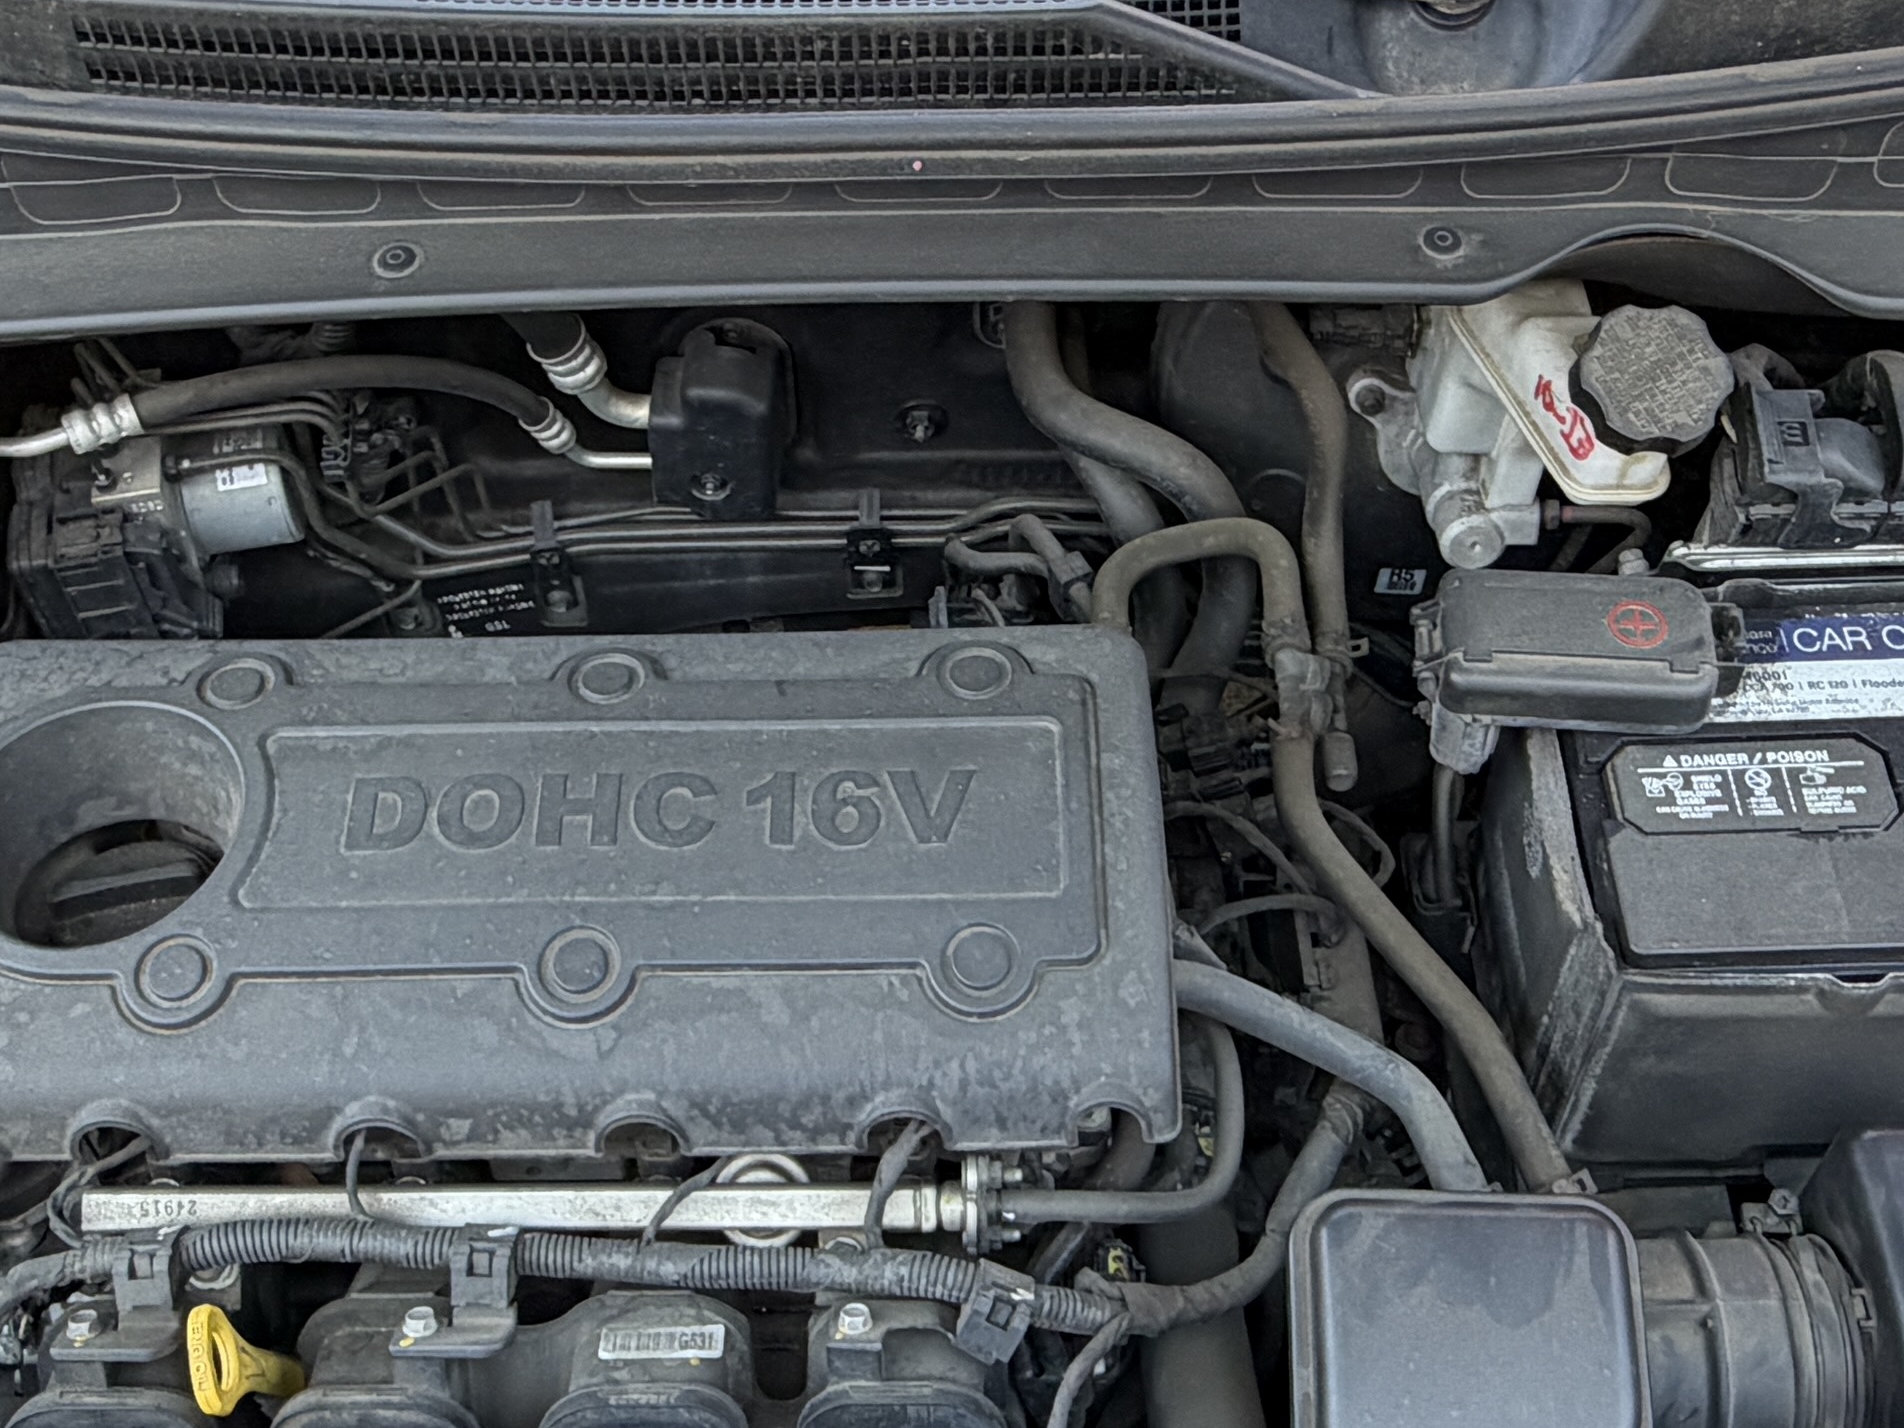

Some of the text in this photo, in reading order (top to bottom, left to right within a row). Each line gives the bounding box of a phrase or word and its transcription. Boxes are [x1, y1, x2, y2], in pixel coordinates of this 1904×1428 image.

[1793, 626, 1873, 653] CAR
[1680, 752, 1750, 767] DANGER
[1765, 749, 1830, 764] POISON
[341, 768, 979, 853] DOHC 16V
